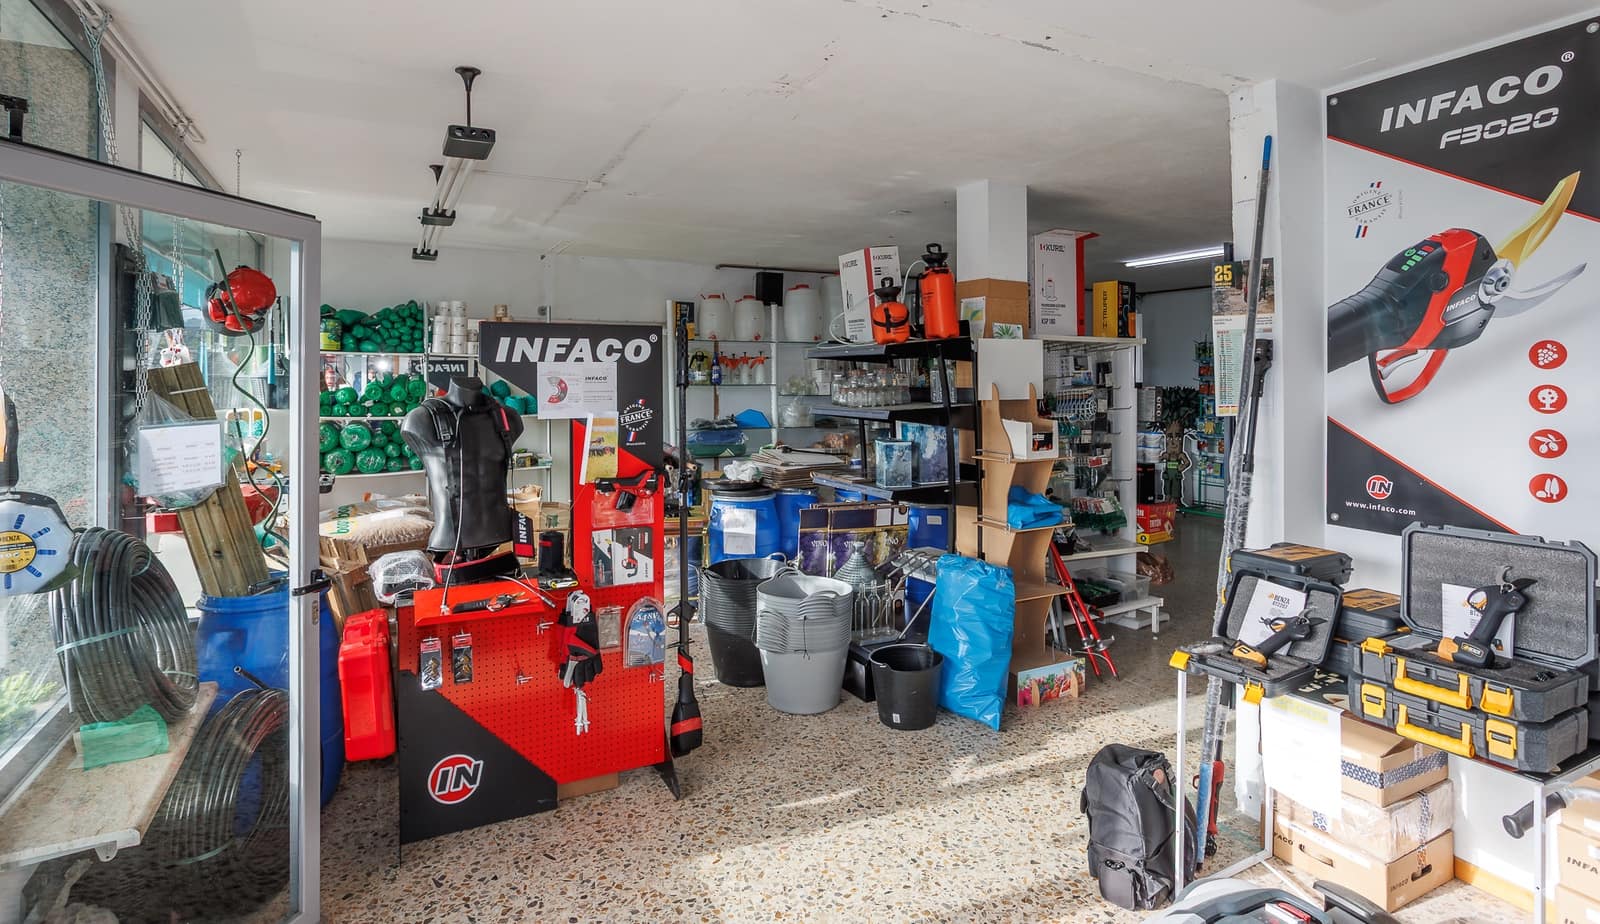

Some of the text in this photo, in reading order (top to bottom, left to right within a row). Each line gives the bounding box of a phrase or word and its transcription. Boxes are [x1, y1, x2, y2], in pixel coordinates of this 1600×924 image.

[1439, 107, 1560, 150] F3020
[1347, 196, 1391, 216] FRANCE
[1215, 265, 1232, 282] 25
[1446, 294, 1477, 312] INFACO
[619, 410, 652, 424] FRANCE
[1370, 480, 1393, 495] IN
[1345, 500, 1416, 516] www.infaco.com
[434, 759, 484, 796] IN
